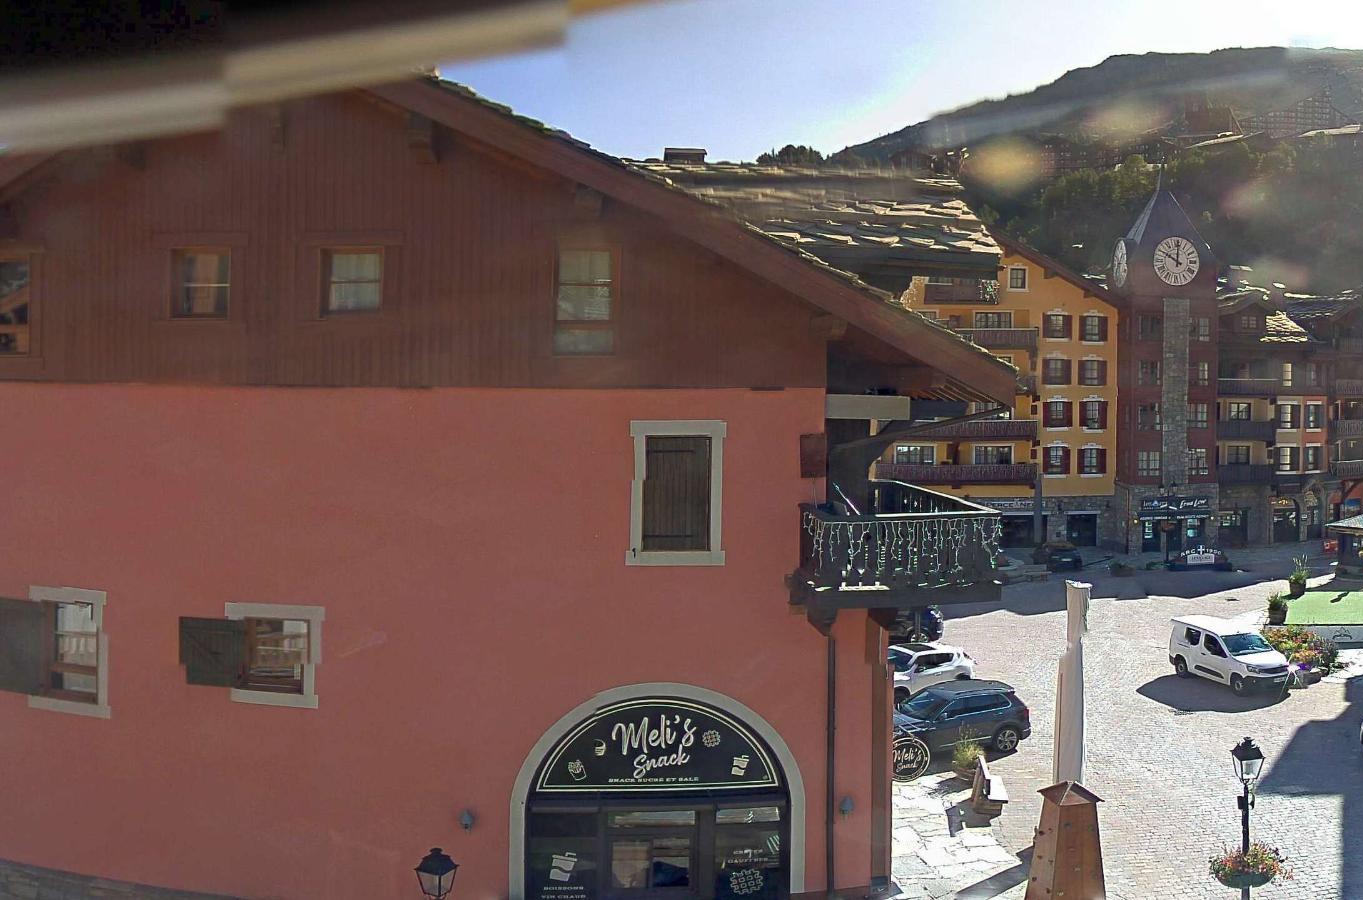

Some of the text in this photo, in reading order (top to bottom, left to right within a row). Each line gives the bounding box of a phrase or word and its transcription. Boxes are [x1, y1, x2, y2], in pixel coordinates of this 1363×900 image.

[611, 715, 697, 756] Meli's
[633, 744, 690, 779] Snack
[892, 748, 922, 763] Meli's
